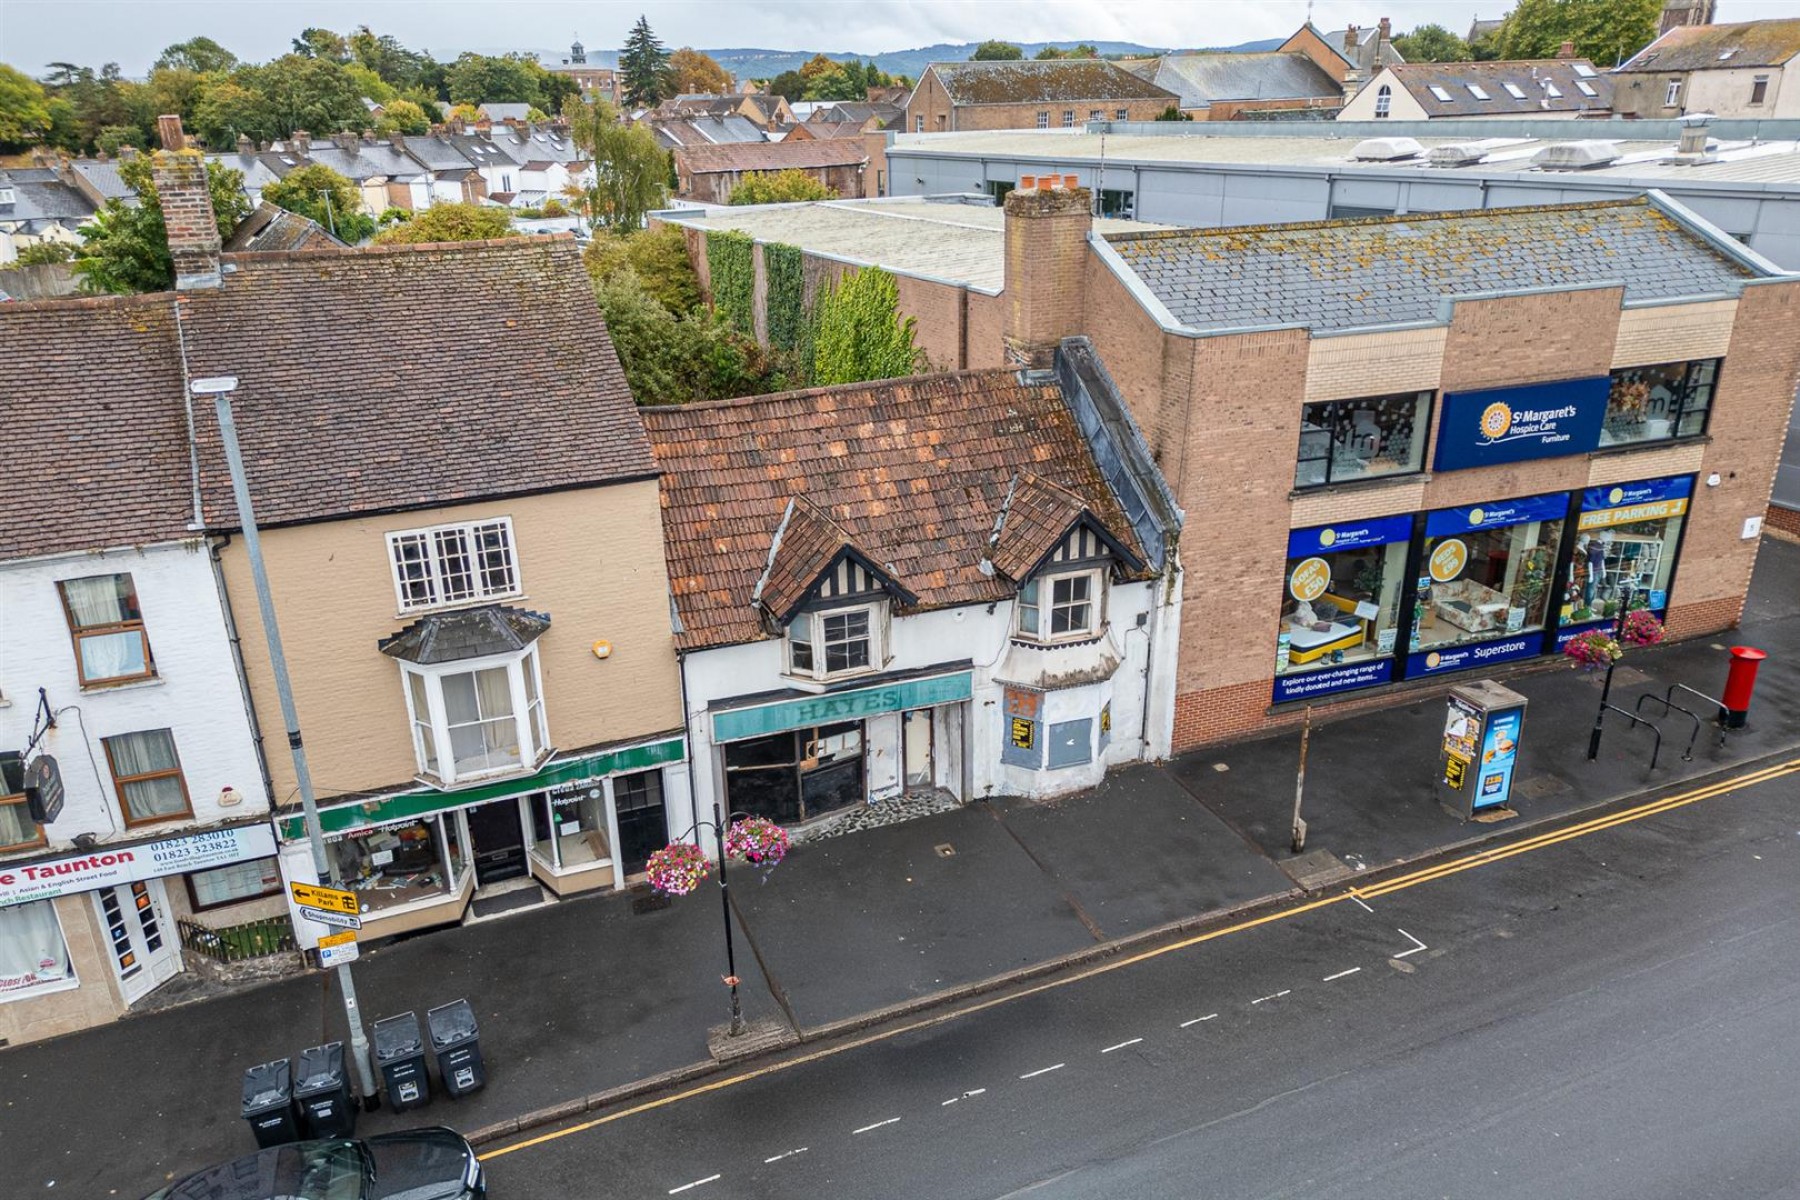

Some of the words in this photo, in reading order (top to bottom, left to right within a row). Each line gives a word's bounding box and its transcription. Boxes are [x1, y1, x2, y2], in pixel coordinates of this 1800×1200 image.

[1523, 405, 1577, 423] Margaret's
[1510, 424, 1539, 435] Hospice
[1540, 421, 1557, 431] Care
[1542, 434, 1571, 444] Furniture
[1582, 511, 1611, 526] FREE
[1613, 503, 1669, 522] PARKING
[1294, 561, 1321, 587] SOFAS
[1473, 640, 1526, 659] Superstore
[1282, 677, 1305, 687] Explore
[1317, 668, 1359, 682] ever-changing
[1359, 664, 1376, 675] range
[1376, 662, 1384, 670] of
[1286, 684, 1304, 694] kindly
[1304, 680, 1330, 691] donated
[1331, 678, 1343, 687] and
[1343, 677, 1356, 685] new
[797, 690, 899, 722] HAYES
[552, 795, 586, 807] Hotpoint
[348, 829, 373, 840] Amica
[379, 819, 419, 833] Hotpoint
[151, 837, 188, 852] 01823
[192, 828, 235, 844] 283010
[153, 847, 191, 862] 01823
[195, 838, 238, 854] 323822
[21, 851, 135, 881] Taunton
[19, 884, 39, 894] Asian
[48, 878, 75, 890] English
[76, 873, 98, 883] Street
[99, 869, 118, 878] Food
[15, 888, 63, 903] Restaurant
[311, 889, 339, 900] Killams
[317, 897, 334, 907] Park
[307, 910, 348, 925] Shopmobility
